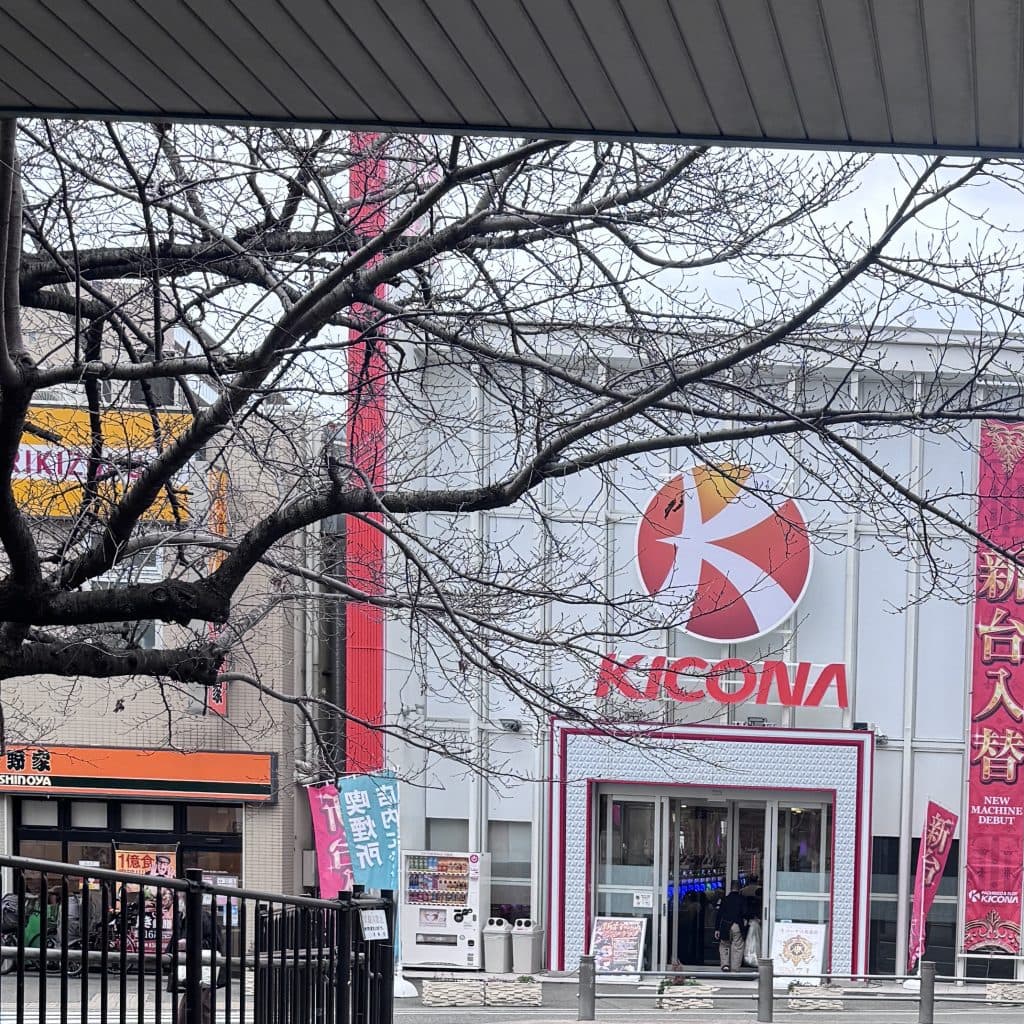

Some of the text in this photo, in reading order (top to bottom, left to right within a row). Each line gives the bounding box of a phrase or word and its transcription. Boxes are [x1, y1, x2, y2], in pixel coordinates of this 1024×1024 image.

[596, 652, 850, 709] KICONA
[6, 750, 52, 772] 野家
[983, 796, 1010, 805] NEW
[971, 806, 1023, 816] MACHINE
[978, 816, 1015, 825] DEBUT
[981, 895, 1019, 904] KICONA
